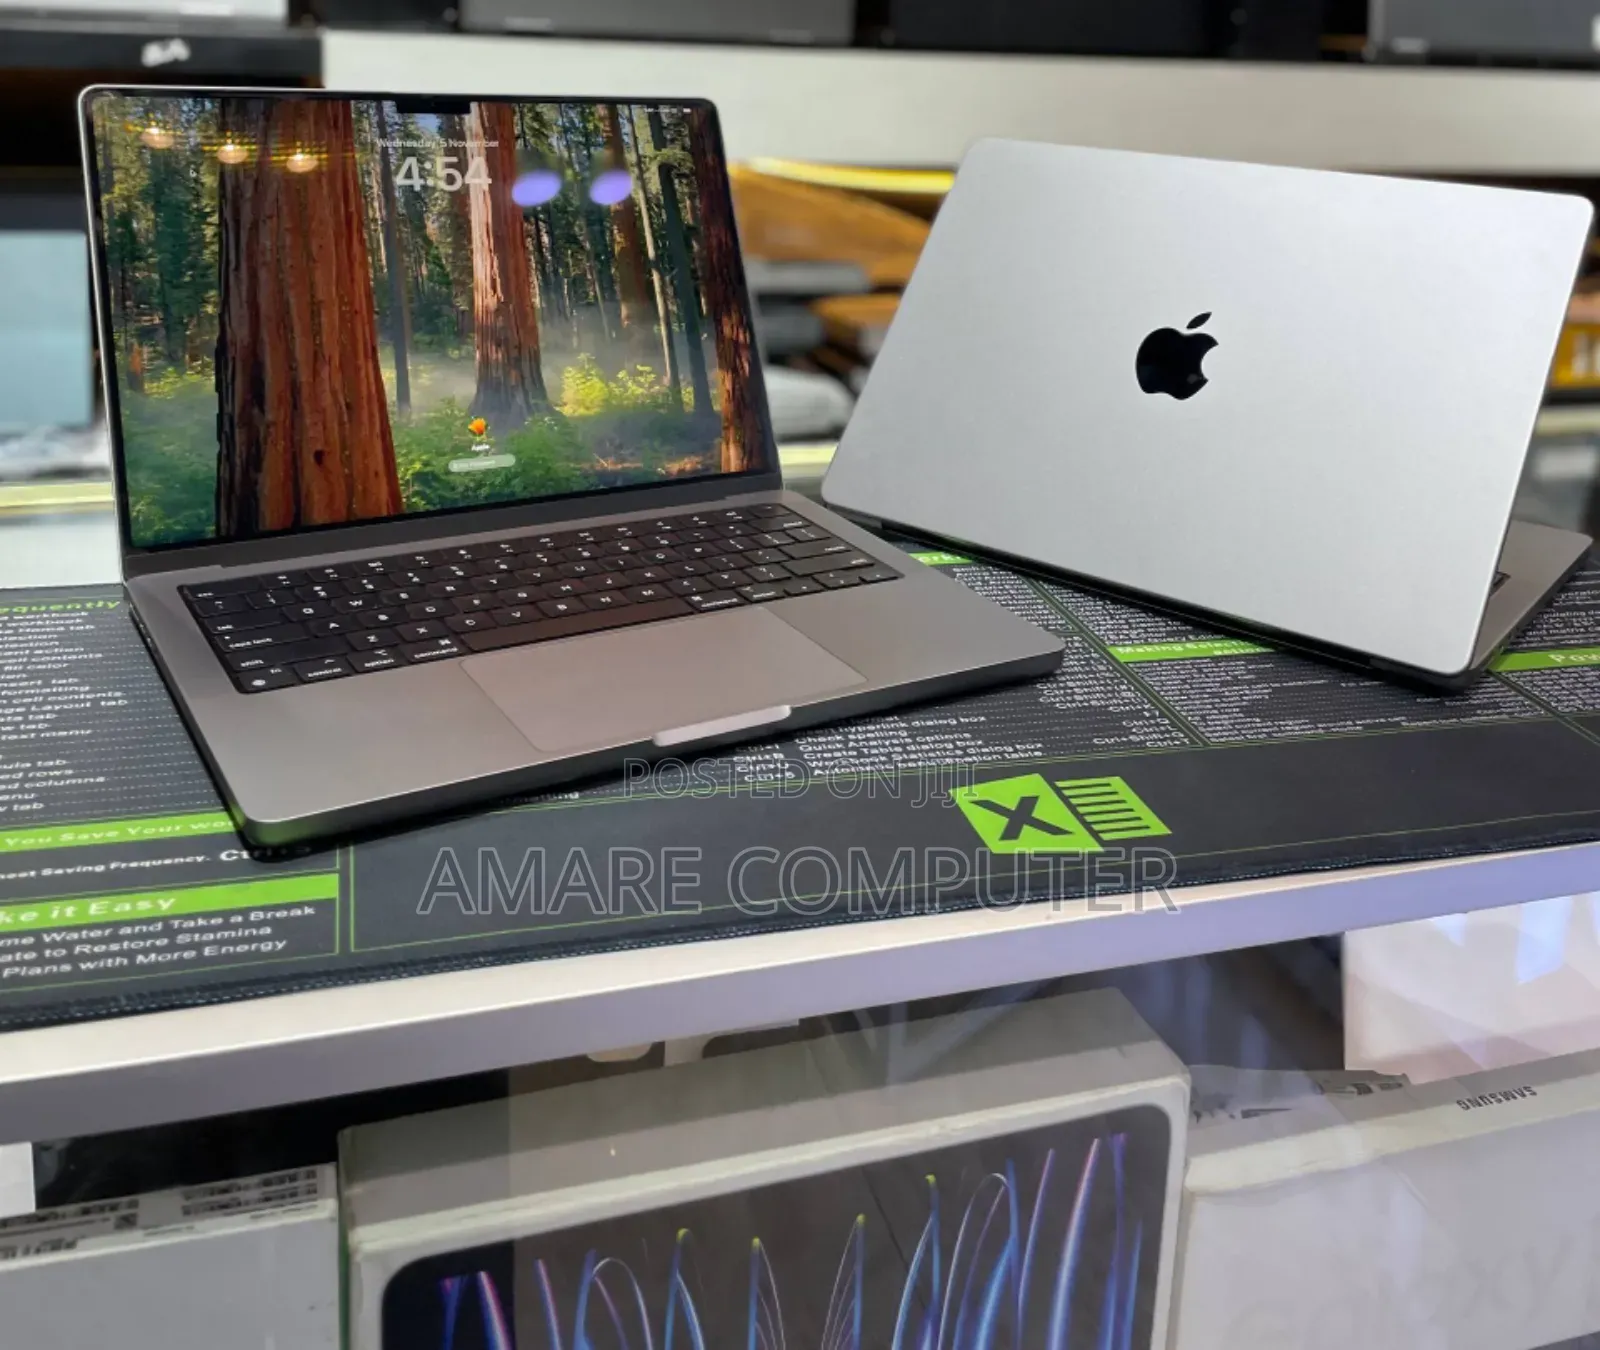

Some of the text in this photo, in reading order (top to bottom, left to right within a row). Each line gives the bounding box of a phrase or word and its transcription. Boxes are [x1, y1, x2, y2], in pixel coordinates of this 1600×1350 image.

[396, 156, 492, 192] 4:54
[59, 829, 120, 842] Save
[127, 825, 182, 836] Your
[41, 864, 106, 876] Saving
[51, 904, 78, 919] it
[89, 897, 176, 916] Easy
[42, 927, 114, 944] Water
[118, 921, 164, 936] and
[169, 916, 224, 930] Take
[229, 914, 244, 923] a
[249, 905, 316, 922] Break
[44, 947, 68, 958] to
[73, 936, 170, 955] Restore
[175, 924, 272, 945] Stamina
[3, 938, 288, 979] Plans with More Energy
[1456, 1085, 1538, 1111] SAMSUNG
